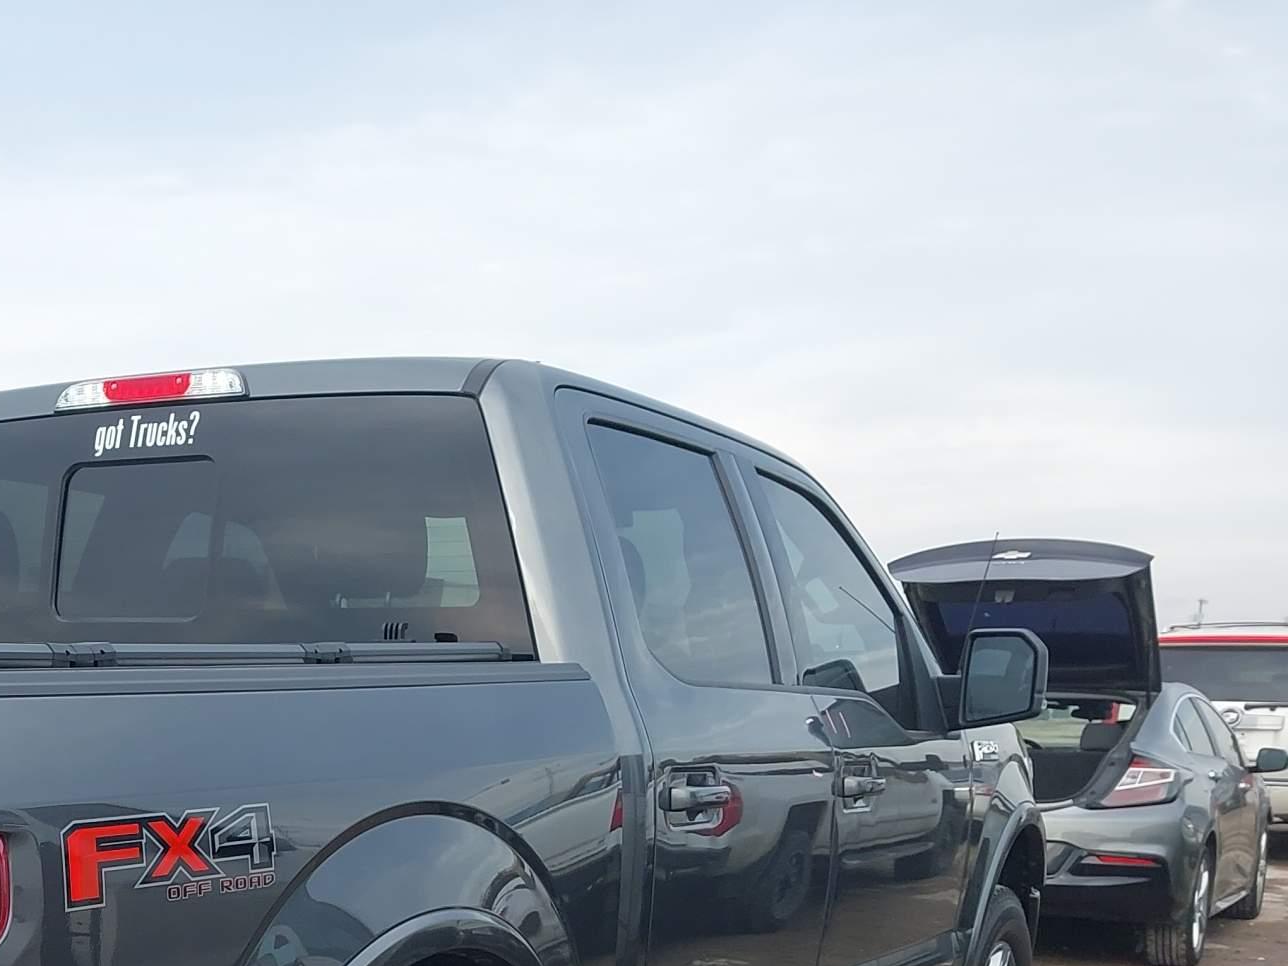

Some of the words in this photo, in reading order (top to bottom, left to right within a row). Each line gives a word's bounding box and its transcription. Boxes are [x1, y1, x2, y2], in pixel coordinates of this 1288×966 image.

[94, 416, 124, 457] got
[129, 410, 201, 449] Trucks?
[60, 802, 276, 913] FX4
[166, 880, 212, 902] OFF
[220, 871, 276, 894] ROAD
